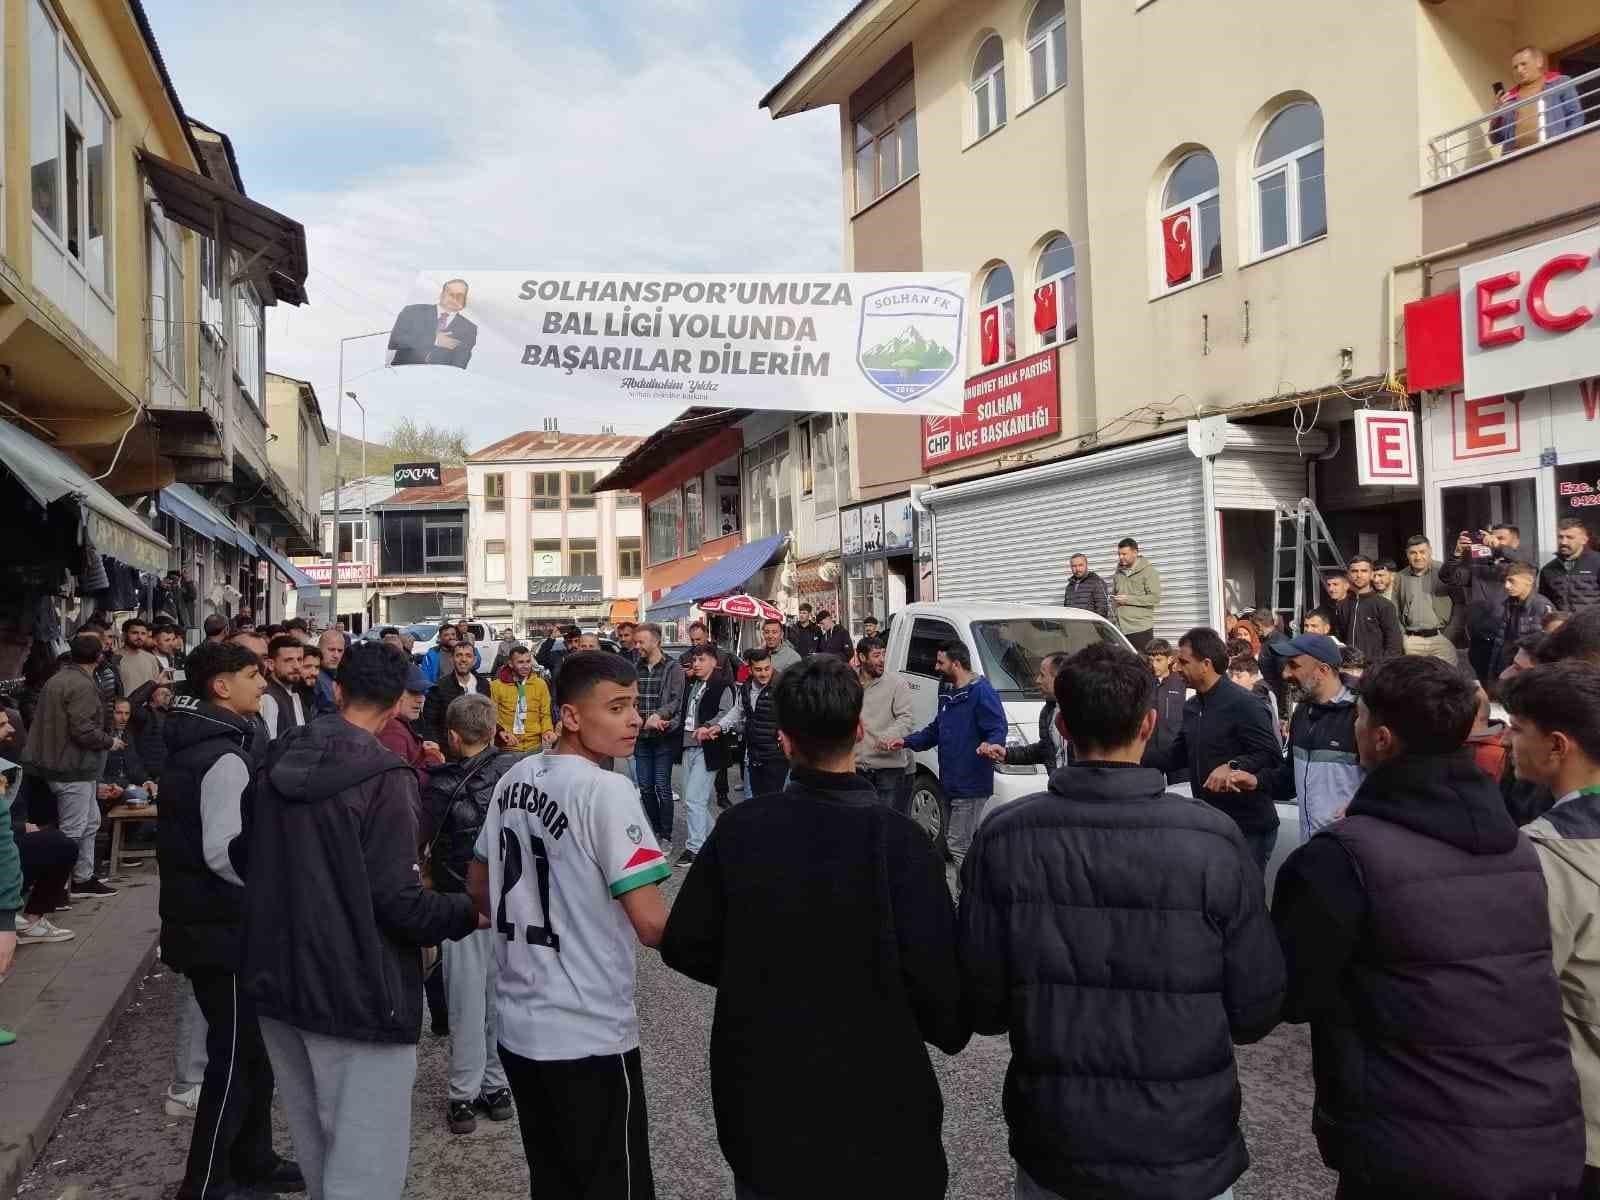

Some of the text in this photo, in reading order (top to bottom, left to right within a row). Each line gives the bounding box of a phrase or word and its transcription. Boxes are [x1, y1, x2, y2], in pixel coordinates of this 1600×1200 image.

[875, 293, 952, 309] SOLHAN FK
[1476, 248, 1600, 348] EC
[542, 305, 817, 341] BAL LİGİ YOLUNDA
[521, 342, 831, 377] BAŞARILAR DİLERİM
[997, 368, 1019, 389] HALK
[1019, 355, 1052, 383] PARTİSİ
[977, 391, 1022, 421] SOLHAN
[1465, 394, 1507, 450] E
[928, 435, 950, 454] CHP
[955, 406, 1049, 451] İLÇE BAŞKANLIĞI
[1377, 427, 1403, 469] E
